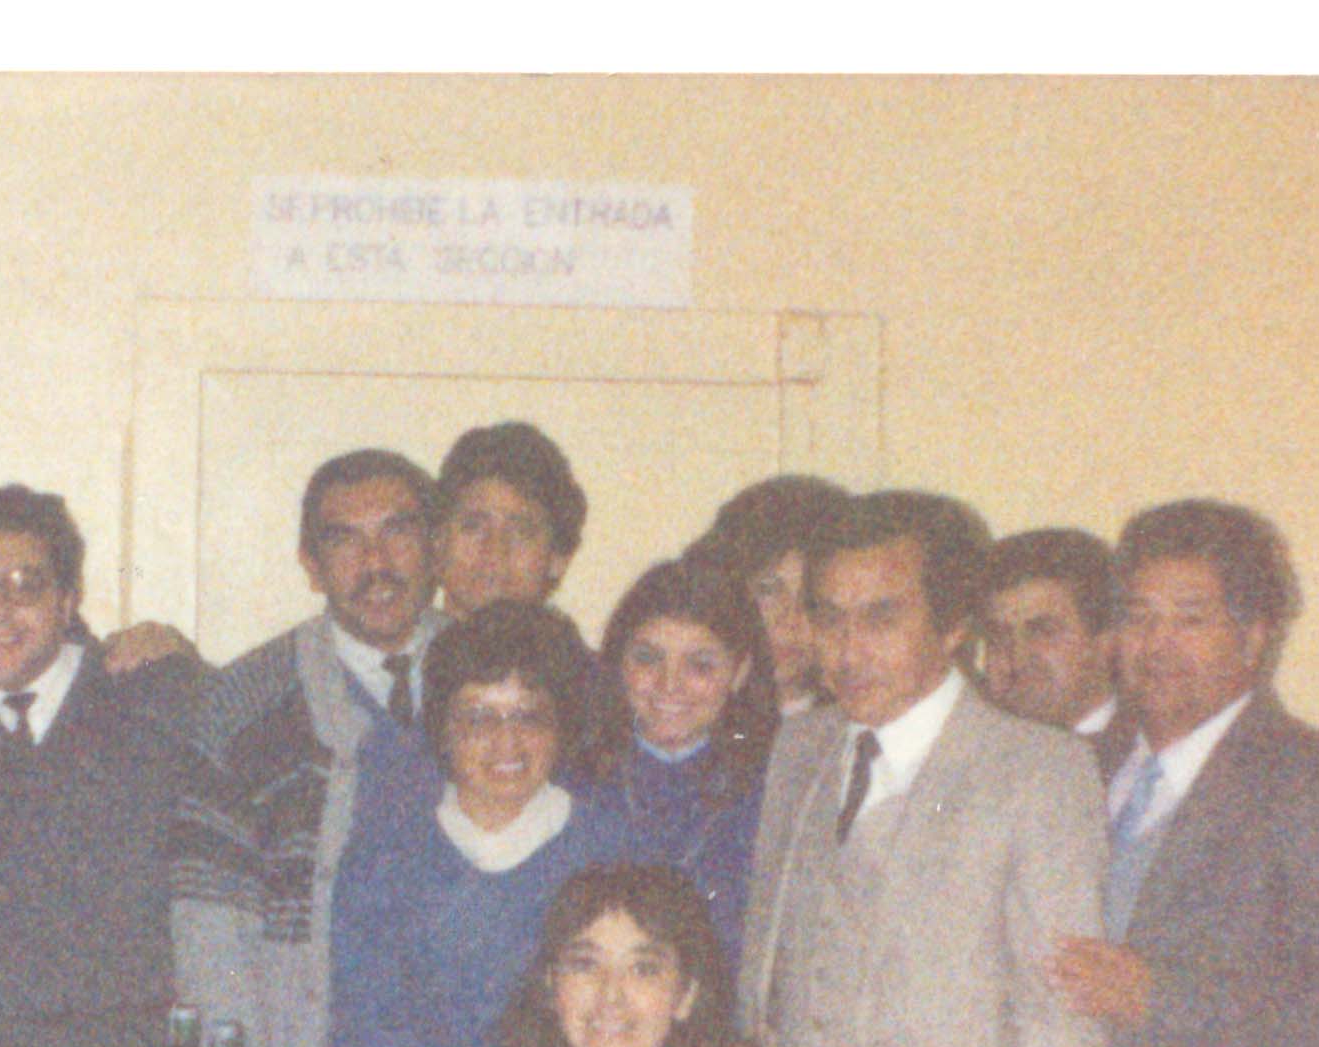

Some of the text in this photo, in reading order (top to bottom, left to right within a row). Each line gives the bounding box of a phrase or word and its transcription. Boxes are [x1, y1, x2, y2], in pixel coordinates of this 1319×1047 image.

[459, 195, 500, 226] LA
[524, 196, 674, 231] ENTRADA
[286, 246, 306, 273] A
[327, 244, 408, 274] ESTA
